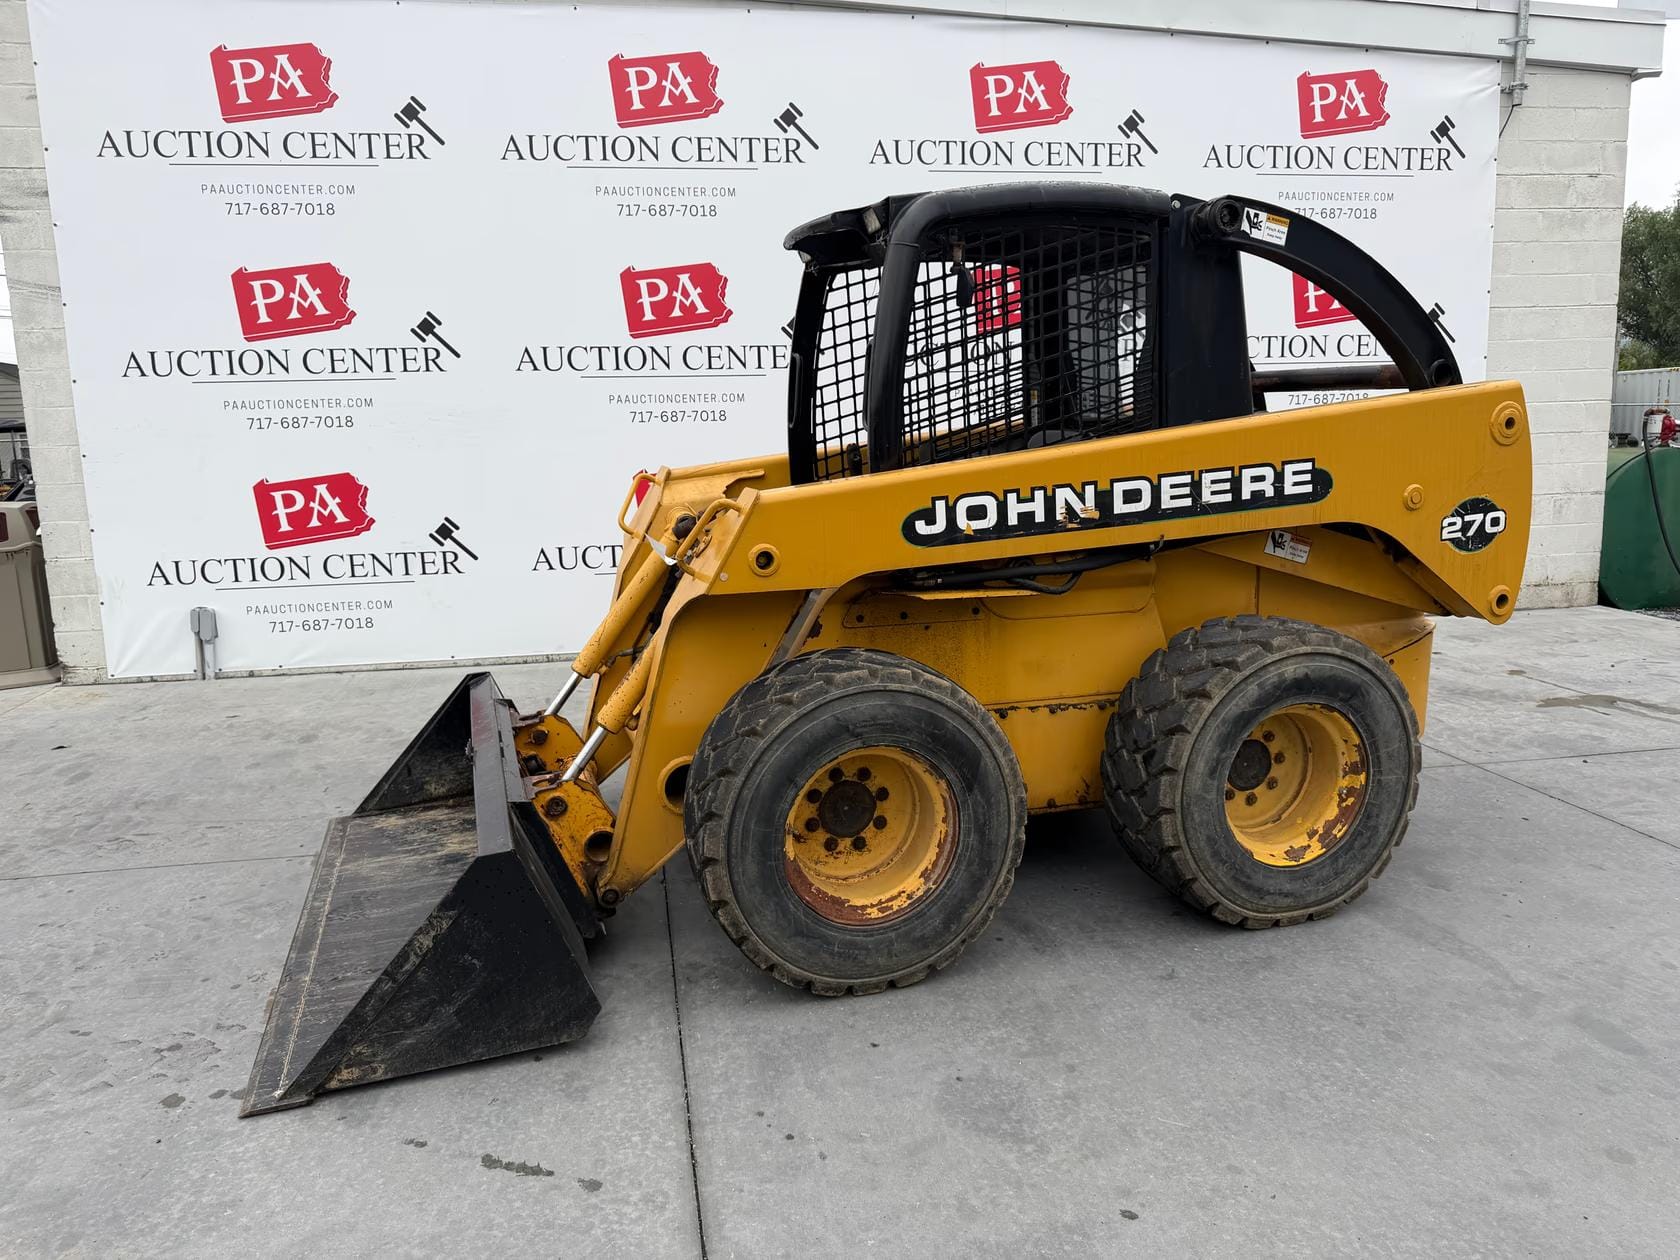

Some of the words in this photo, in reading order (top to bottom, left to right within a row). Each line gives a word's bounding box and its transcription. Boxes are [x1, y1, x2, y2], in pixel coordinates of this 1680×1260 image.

[228, 54, 312, 104] PA
[625, 62, 699, 110] PA
[984, 71, 1051, 116] PA
[1310, 79, 1370, 122] PA
[97, 130, 270, 159] AUCTION
[281, 131, 431, 160] CENTER
[501, 134, 660, 161] AUCTION
[672, 137, 806, 163] CENTER
[869, 140, 1014, 166] AUCTION
[1024, 141, 1145, 167] CENTER
[1203, 144, 1335, 169] AUCTION
[1344, 146, 1453, 171] CENTER
[201, 184, 355, 195] PAAUCTIONCENTER.COM
[596, 186, 736, 197] PAAUCTIONCENTER.COM
[1279, 192, 1394, 202] PAAUCTIONCENTER.COM
[225, 203, 335, 215] 717-687-7018
[617, 204, 717, 217] 717-687-7018
[248, 274, 330, 324] PA
[635, 273, 710, 321] PA
[516, 346, 672, 371] AUCTION
[683, 344, 790, 370] CENTE
[1247, 334, 1329, 358] CTION
[122, 349, 290, 377] AUCTION
[302, 347, 447, 374] CENTER
[224, 398, 373, 410] PAAUCTIONCENTER.COM
[609, 393, 745, 404] PAAUCTIONCENTER.COM
[246, 416, 354, 430] 717-687-7018
[629, 410, 727, 423] 717-687-7018
[269, 484, 350, 532] PA
[914, 484, 1099, 536] JOHN
[1112, 461, 1314, 514] DEERE
[1441, 510, 1506, 541] 270
[147, 556, 312, 587] AUCTION
[322, 550, 465, 580] CENTER
[532, 545, 624, 571] AUCT
[246, 600, 393, 614] PAAUCTIONCENTER.COM
[269, 617, 374, 633] 717-687-7018
